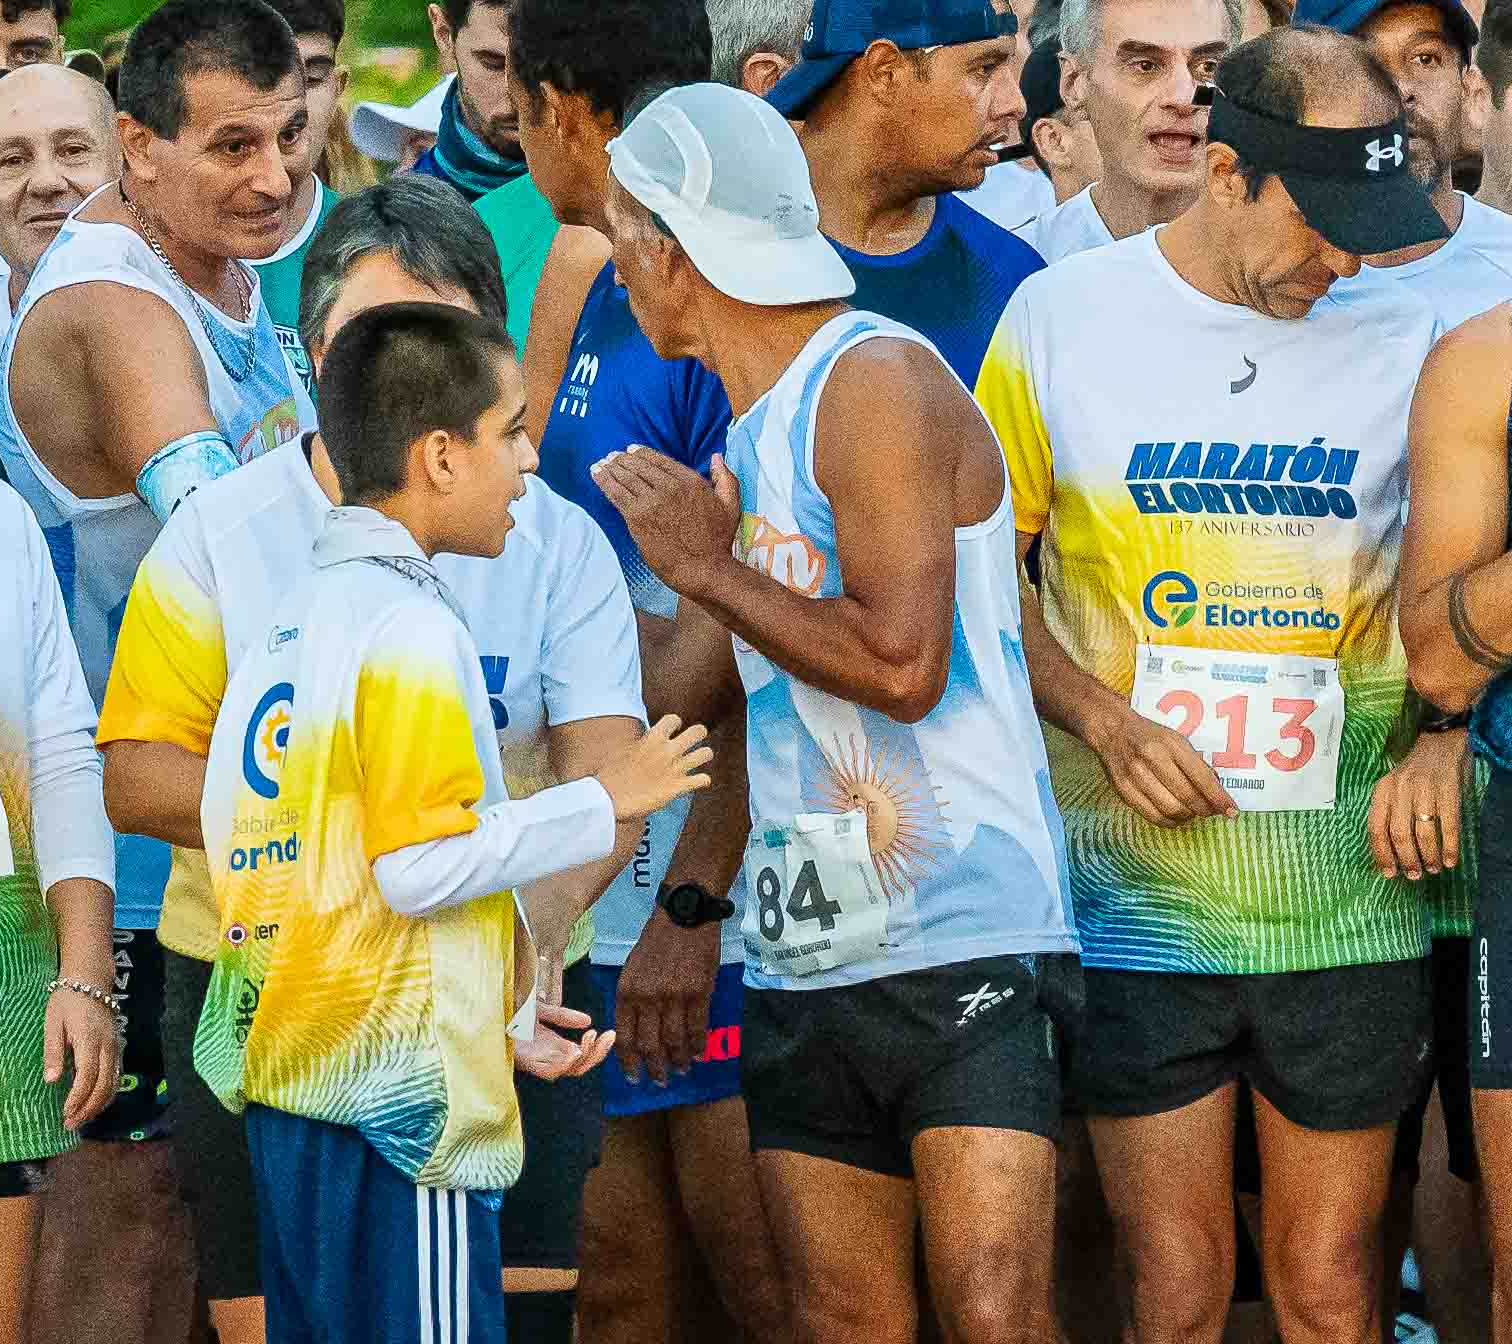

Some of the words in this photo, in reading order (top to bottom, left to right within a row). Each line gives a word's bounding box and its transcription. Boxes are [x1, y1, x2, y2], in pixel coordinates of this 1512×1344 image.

[1125, 437, 1360, 485] MARATÓN
[1130, 483, 1360, 521] ELORTONDO
[1169, 520, 1196, 536] 137
[1199, 519, 1315, 537] ANIVERSARIO
[1205, 581, 1296, 600] Gobierno
[1302, 583, 1324, 600] de
[1205, 602, 1340, 631] Elortondo
[1156, 688, 1319, 772] 213
[757, 859, 842, 943] 84
[1478, 937, 1492, 1058] capitán
